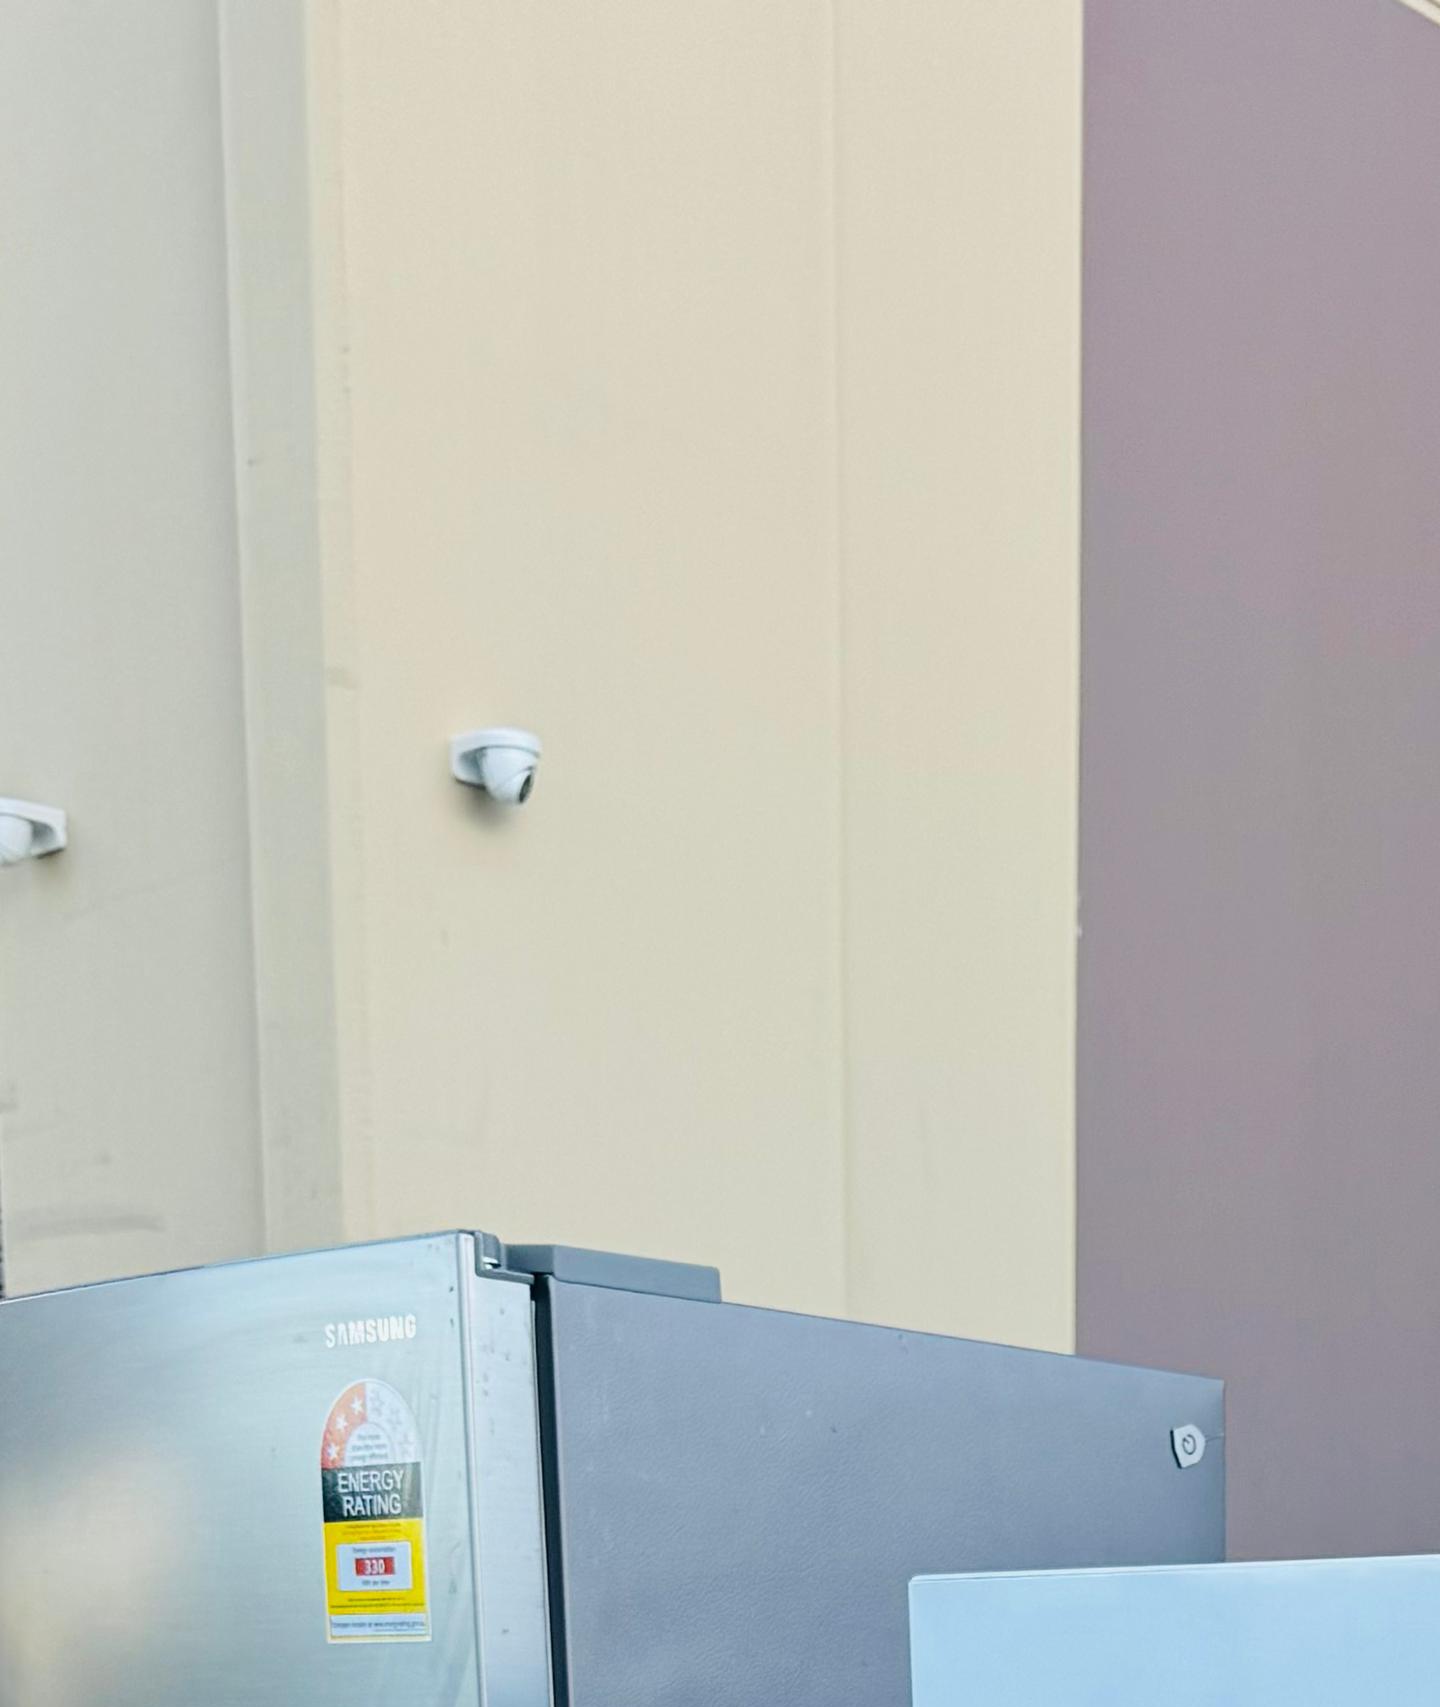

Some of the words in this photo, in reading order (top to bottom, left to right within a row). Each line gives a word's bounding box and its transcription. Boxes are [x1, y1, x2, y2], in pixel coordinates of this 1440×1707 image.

[325, 1313, 416, 1348] SAMSUNG
[338, 1469, 403, 1493] ENERGY
[343, 1493, 401, 1517] RATING
[365, 1558, 386, 1575] 330
